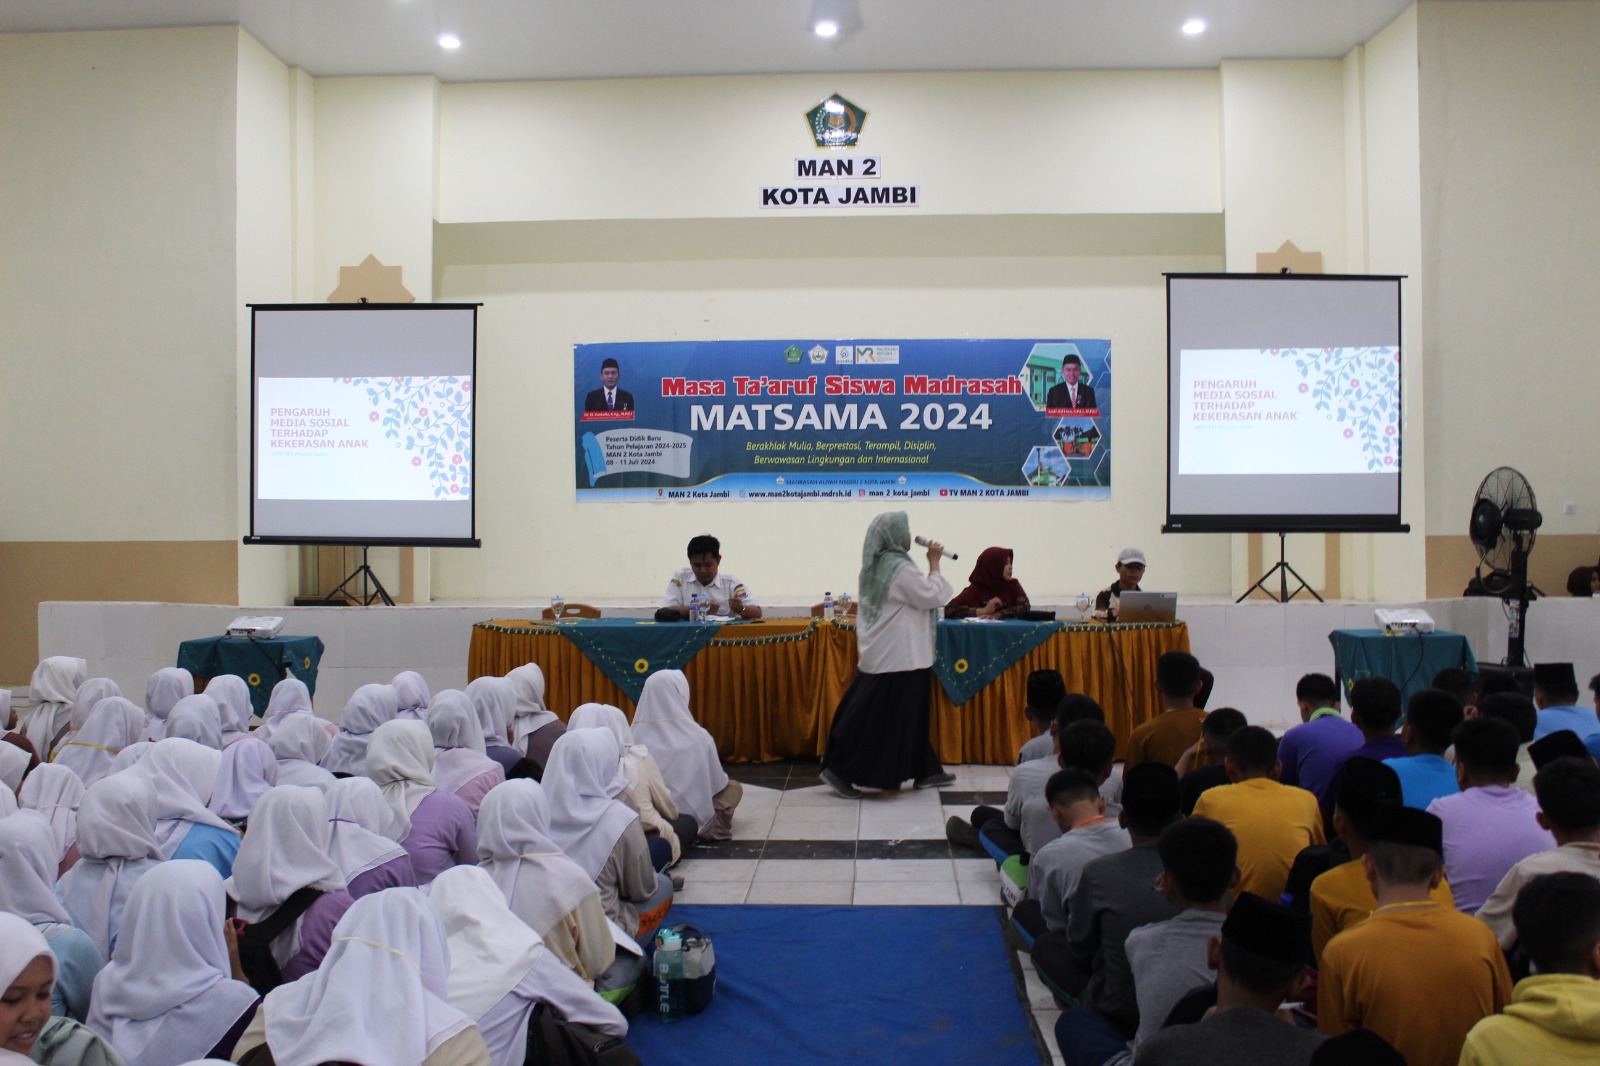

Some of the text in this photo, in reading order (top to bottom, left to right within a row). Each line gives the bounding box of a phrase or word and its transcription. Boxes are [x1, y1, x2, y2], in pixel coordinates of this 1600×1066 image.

[797, 158, 877, 176] MAN 2
[762, 186, 916, 205] KOTA JAMBI
[662, 377, 726, 397] Masa
[825, 375, 895, 396] Siswa
[904, 375, 1022, 395] Madrasah
[1194, 380, 1257, 389] PENGARUH
[1193, 390, 1278, 400] MEDIA SOSIAL
[1193, 402, 1255, 410] TERHADAP
[270, 408, 330, 416] PENGARUH
[690, 402, 993, 431] MATSAMA 2024
[1193, 412, 1298, 422] KEKERASAN ANAK
[270, 418, 350, 427] MEDIA SOSIAL
[271, 429, 328, 438] TERHADAP
[270, 439, 369, 448] KEKERASAN ANAK
[746, 441, 937, 452] Berakhlak Mulia, Berprestasi, Terampil, Disiplin,
[754, 455, 929, 466] Berwawasan Lingkungan dan Internasional
[748, 490, 852, 499] www.man2kotajambi.mdrsh.id
